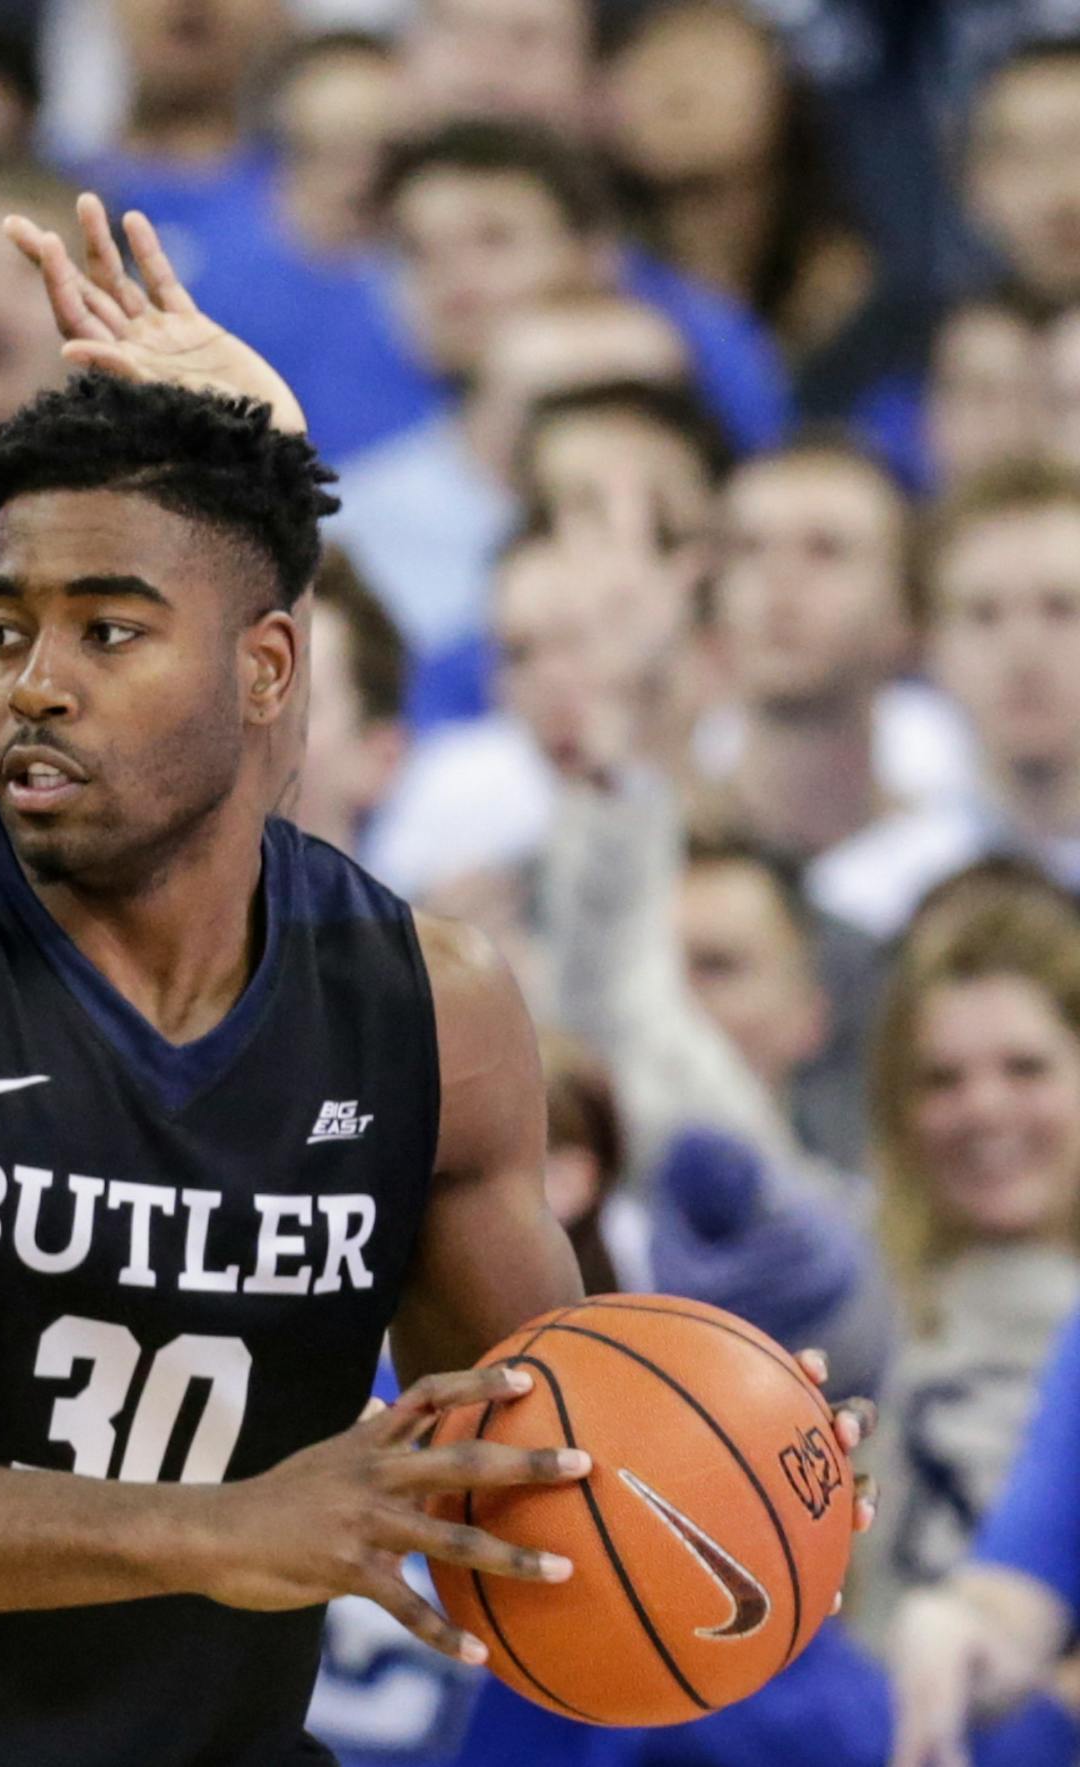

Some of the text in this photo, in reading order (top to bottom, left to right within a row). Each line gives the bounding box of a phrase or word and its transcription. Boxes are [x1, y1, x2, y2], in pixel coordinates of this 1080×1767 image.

[319, 1099, 360, 1119] BIG
[311, 1113, 375, 1136] EAST
[10, 1313, 254, 1486] 30
